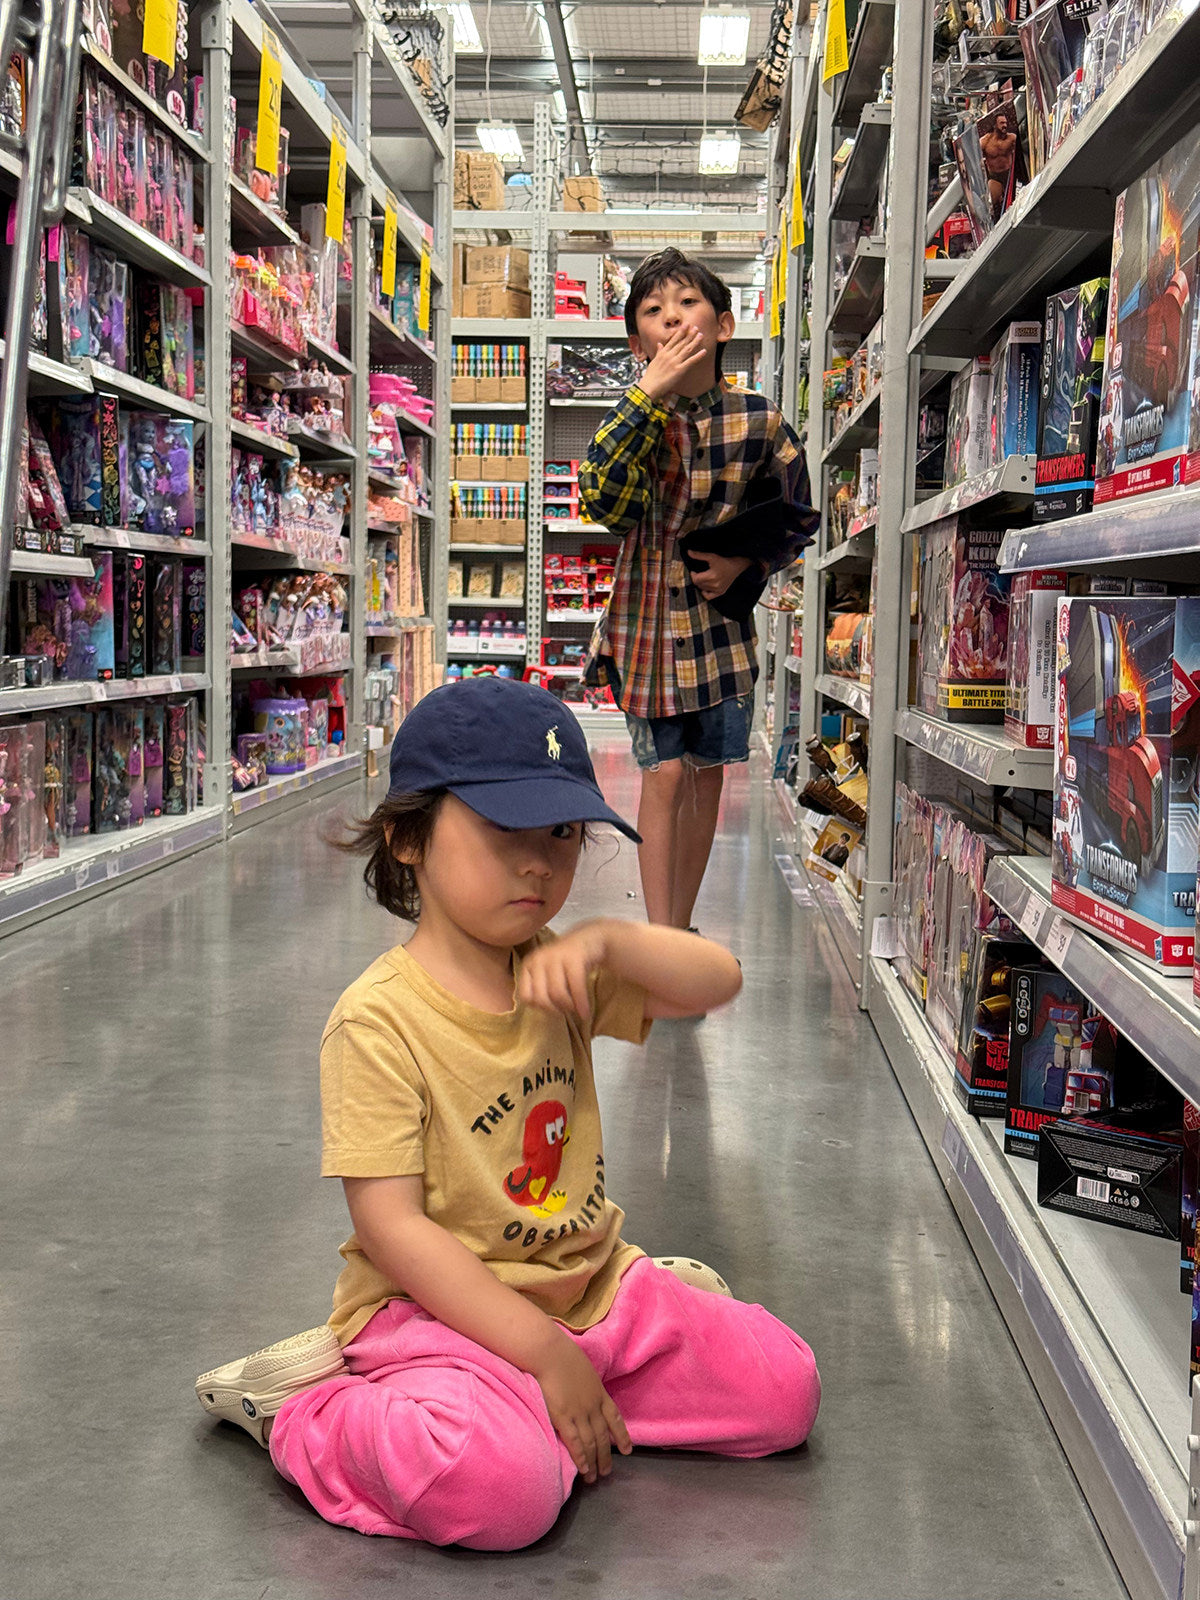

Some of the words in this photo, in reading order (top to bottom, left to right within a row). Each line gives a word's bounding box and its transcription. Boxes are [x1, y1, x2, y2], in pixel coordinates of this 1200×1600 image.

[970, 531, 1004, 543] GODZIL
[969, 547, 999, 560] KON
[953, 689, 988, 697] ULTIMATE
[1086, 844, 1138, 894] TRANSFORMERS
[974, 1078, 1008, 1089] TRANSFO
[471, 1092, 515, 1135] THE
